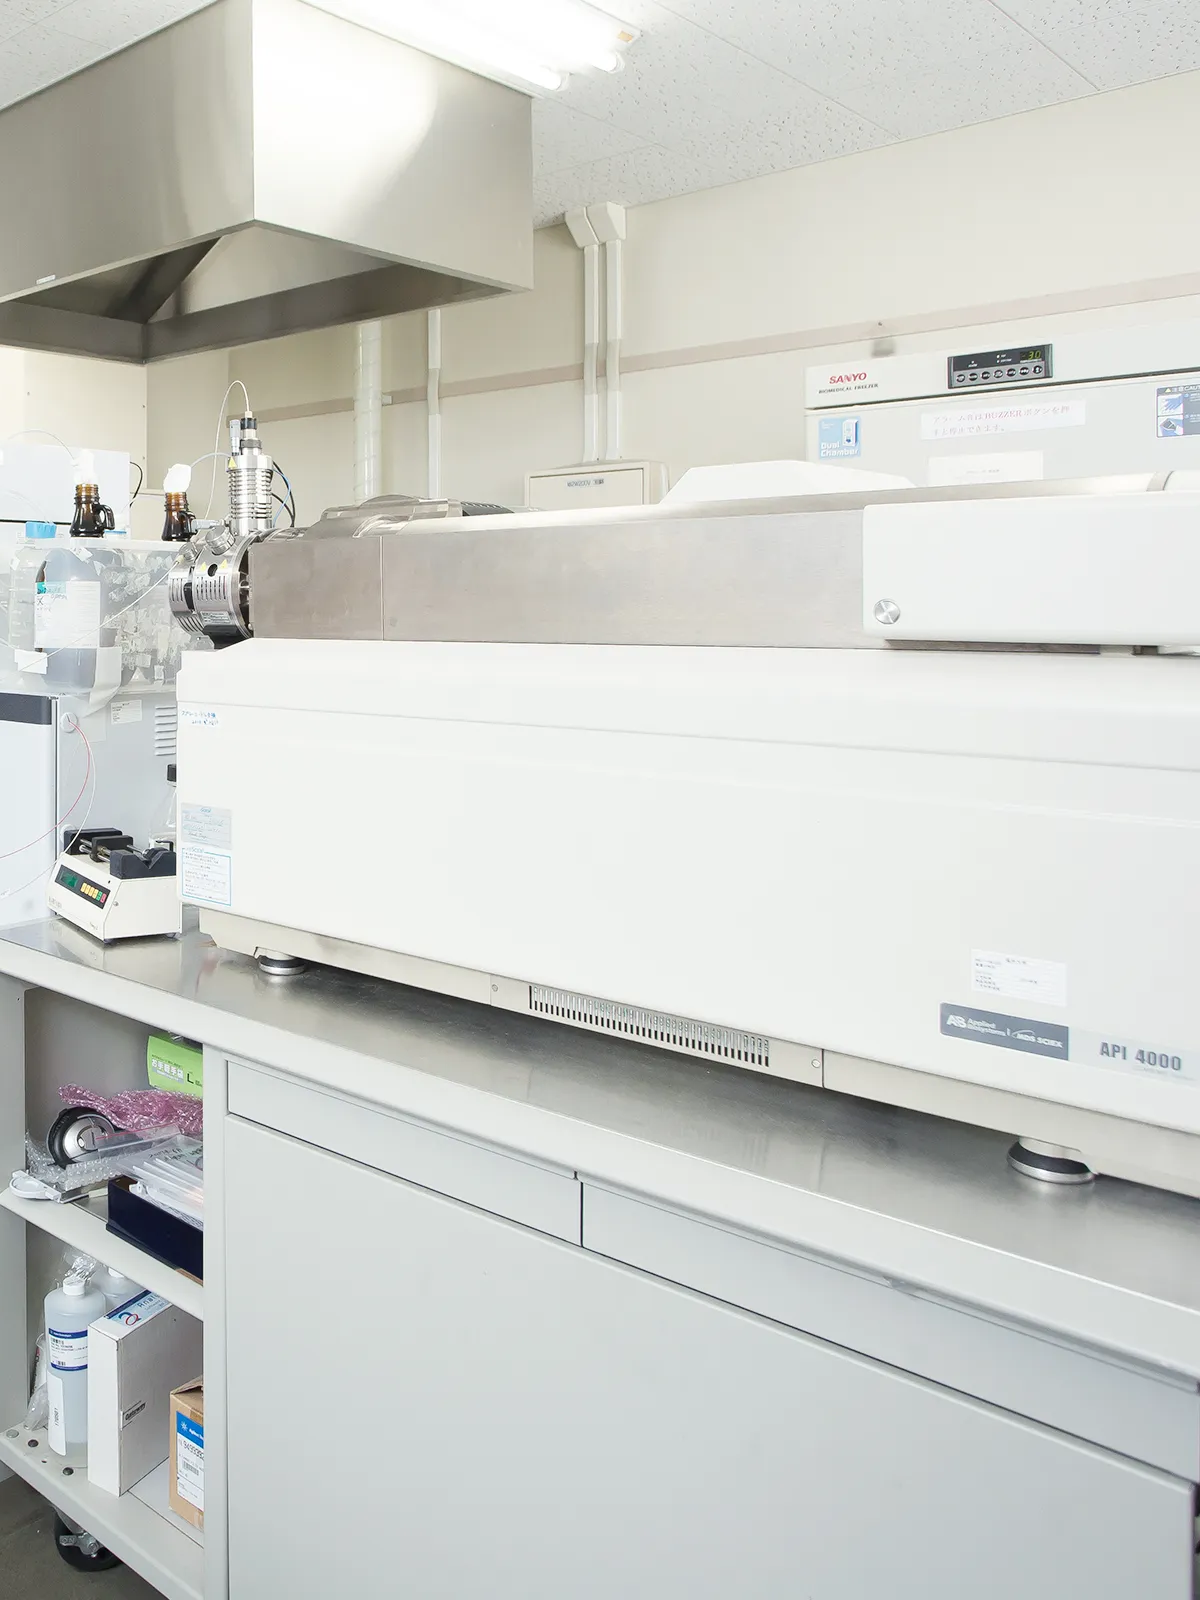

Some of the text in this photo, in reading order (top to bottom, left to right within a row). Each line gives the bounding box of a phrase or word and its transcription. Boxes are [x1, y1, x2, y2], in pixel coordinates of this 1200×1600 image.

[829, 372, 867, 384] SANYO
[818, 383, 879, 395] BIOMEDICAL FREEZER
[821, 441, 840, 450] Dual
[821, 447, 859, 457] Chamber
[967, 1018, 996, 1029] Applied
[1016, 1033, 1063, 1048] MDS SCIEX
[1099, 1041, 1182, 1072] API 4000
[187, 1073, 194, 1084] L
